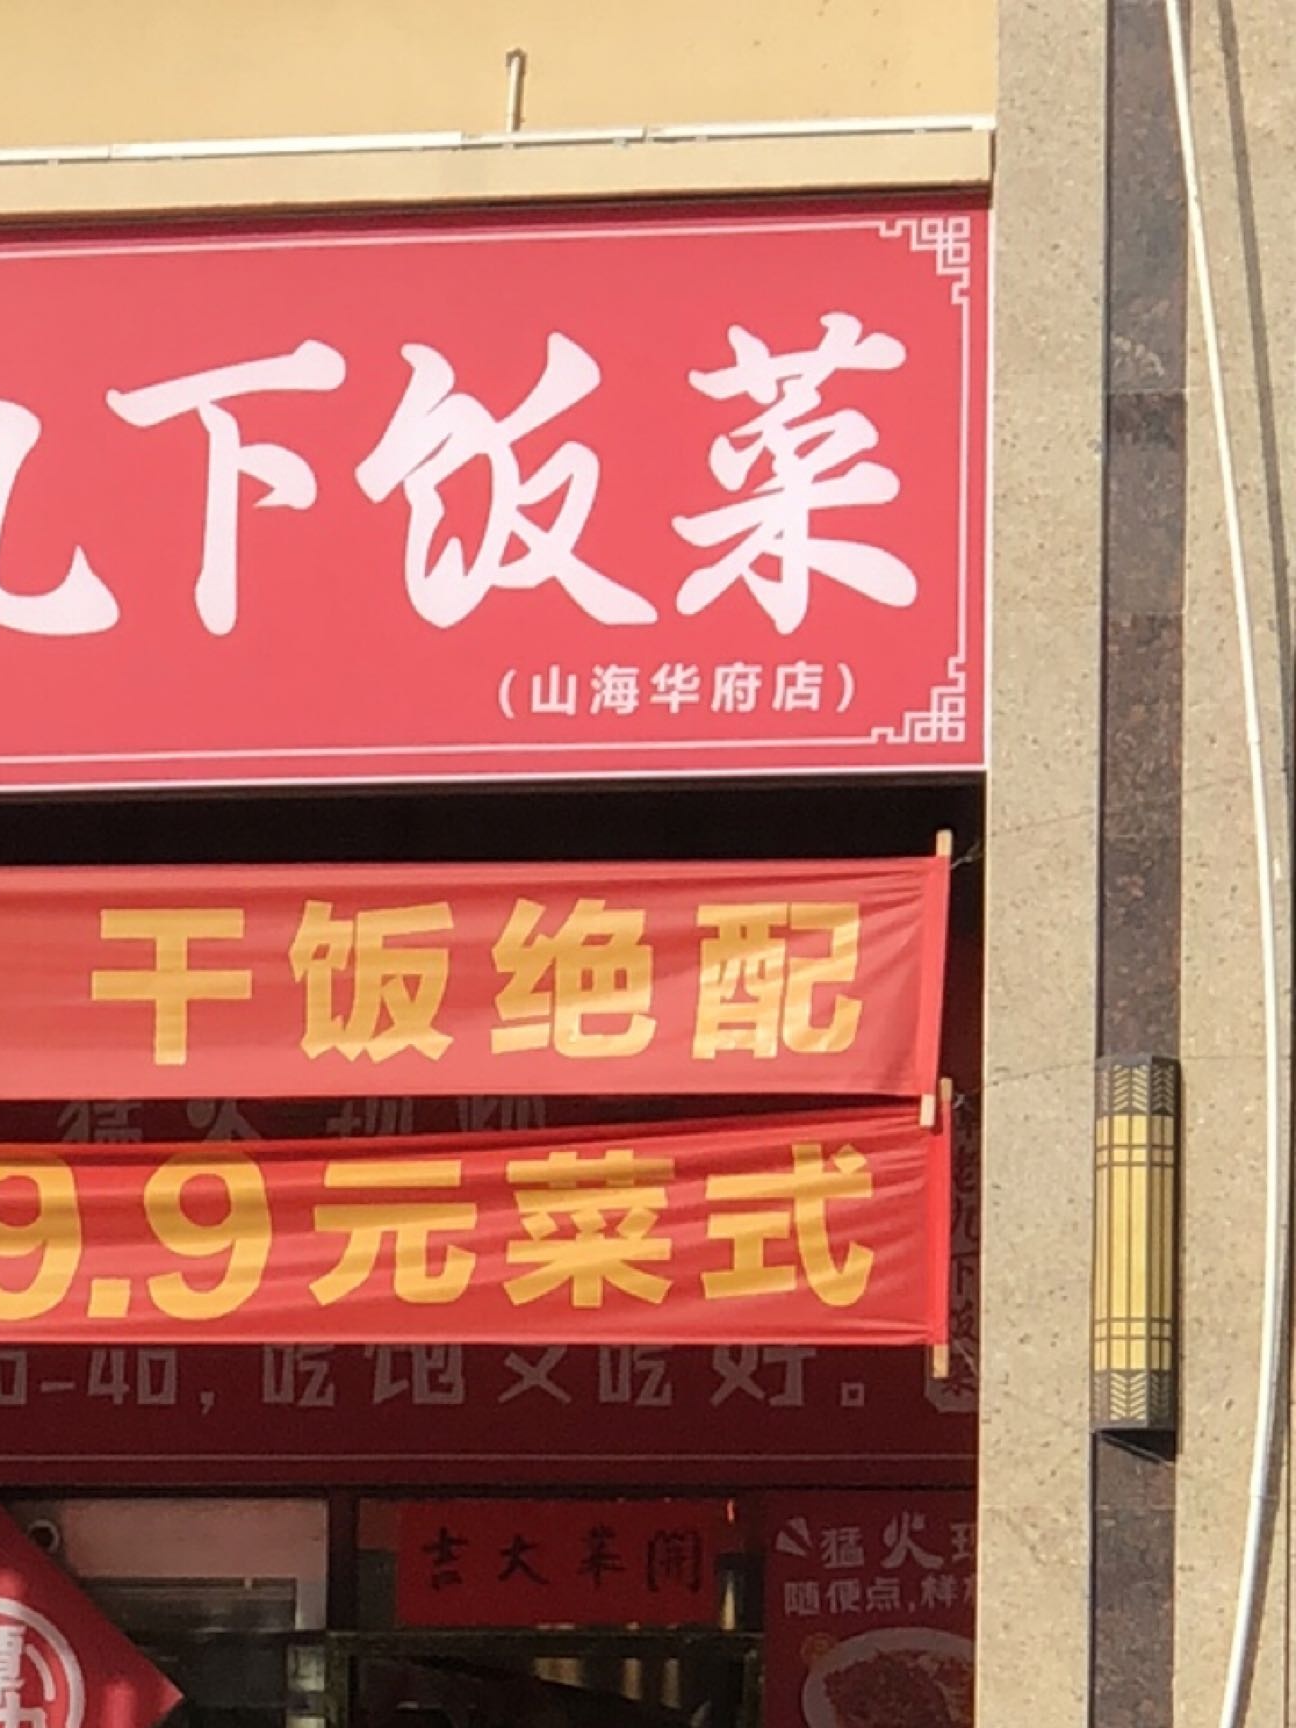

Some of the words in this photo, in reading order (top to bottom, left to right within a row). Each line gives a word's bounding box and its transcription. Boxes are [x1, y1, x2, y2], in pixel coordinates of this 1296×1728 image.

[498, 661, 856, 719] （山海华府店）
[90, 898, 862, 1067] 干饭绝配
[820, 1511, 977, 1569] 猛火
